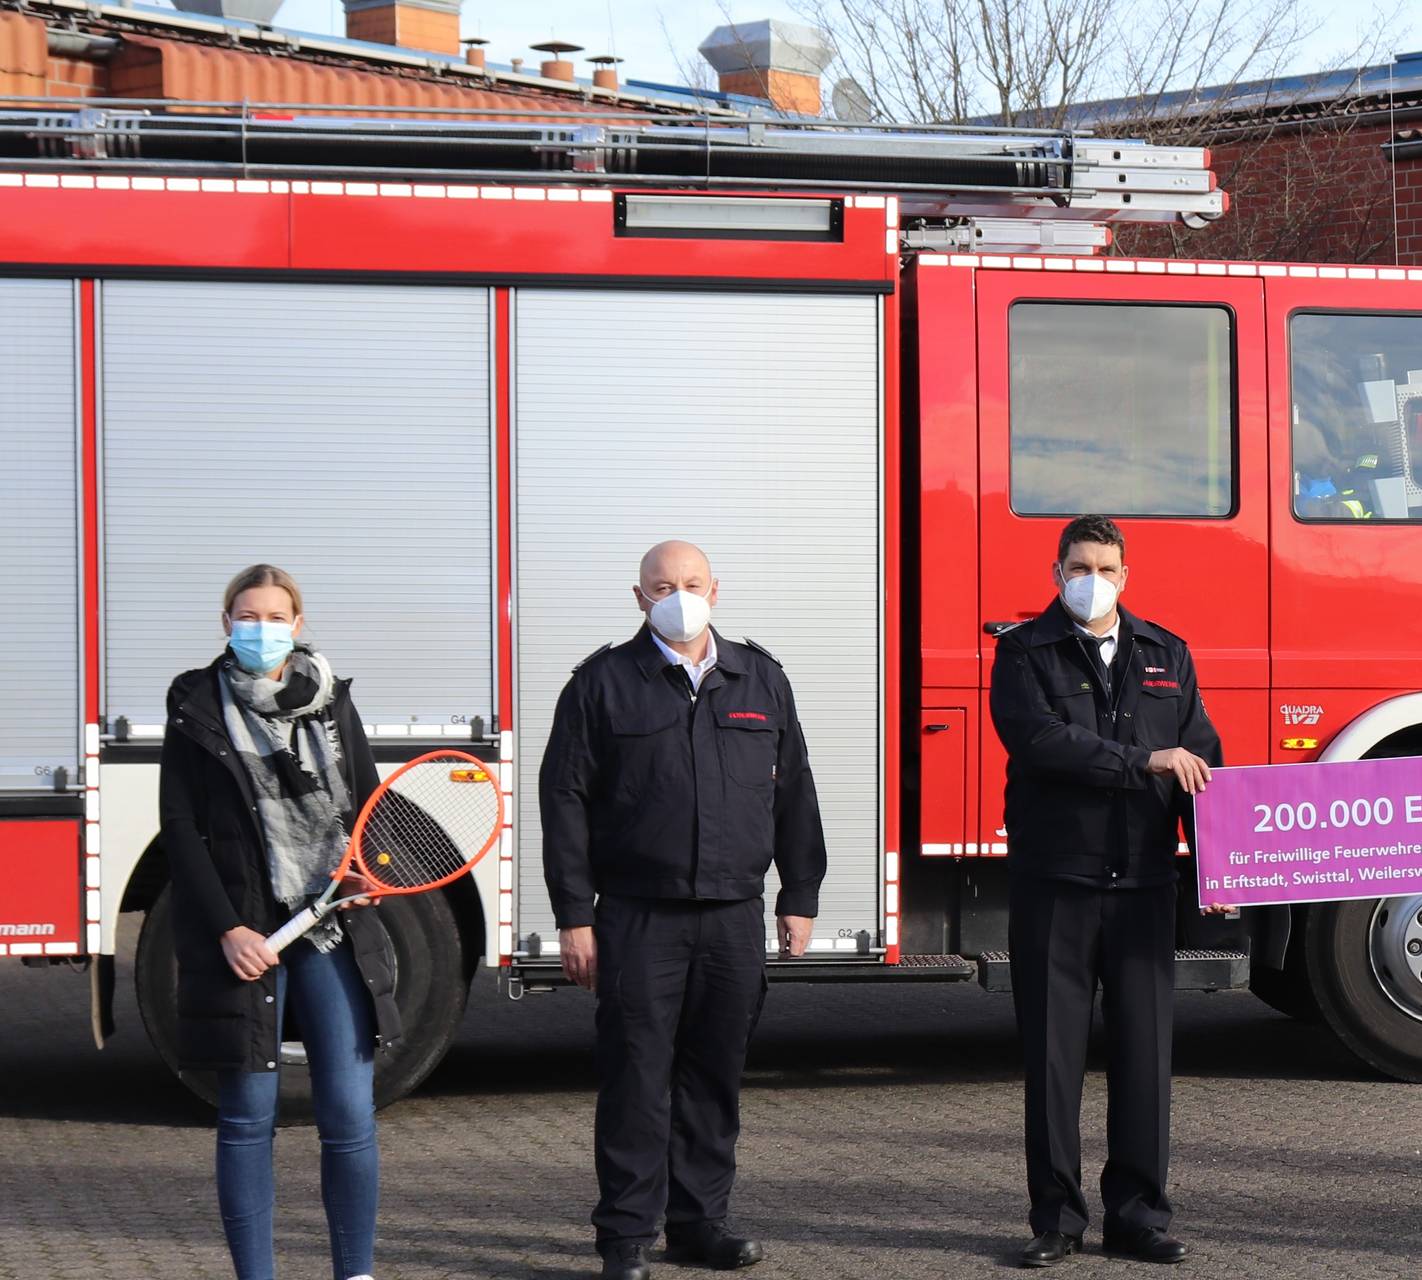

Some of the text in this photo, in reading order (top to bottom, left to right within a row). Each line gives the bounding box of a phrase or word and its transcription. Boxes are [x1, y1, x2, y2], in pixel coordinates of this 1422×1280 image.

[1279, 704, 1325, 714] QUADRA
[450, 714, 466, 725] G4
[1253, 797, 1394, 833] 200.000
[1229, 850, 1251, 865] für
[1254, 847, 1331, 865] Freiwillige
[1206, 876, 1219, 890] in
[1223, 873, 1289, 889] Erftstadt,
[1293, 869, 1354, 886] Swisttal,
[837, 928, 853, 938] G2
